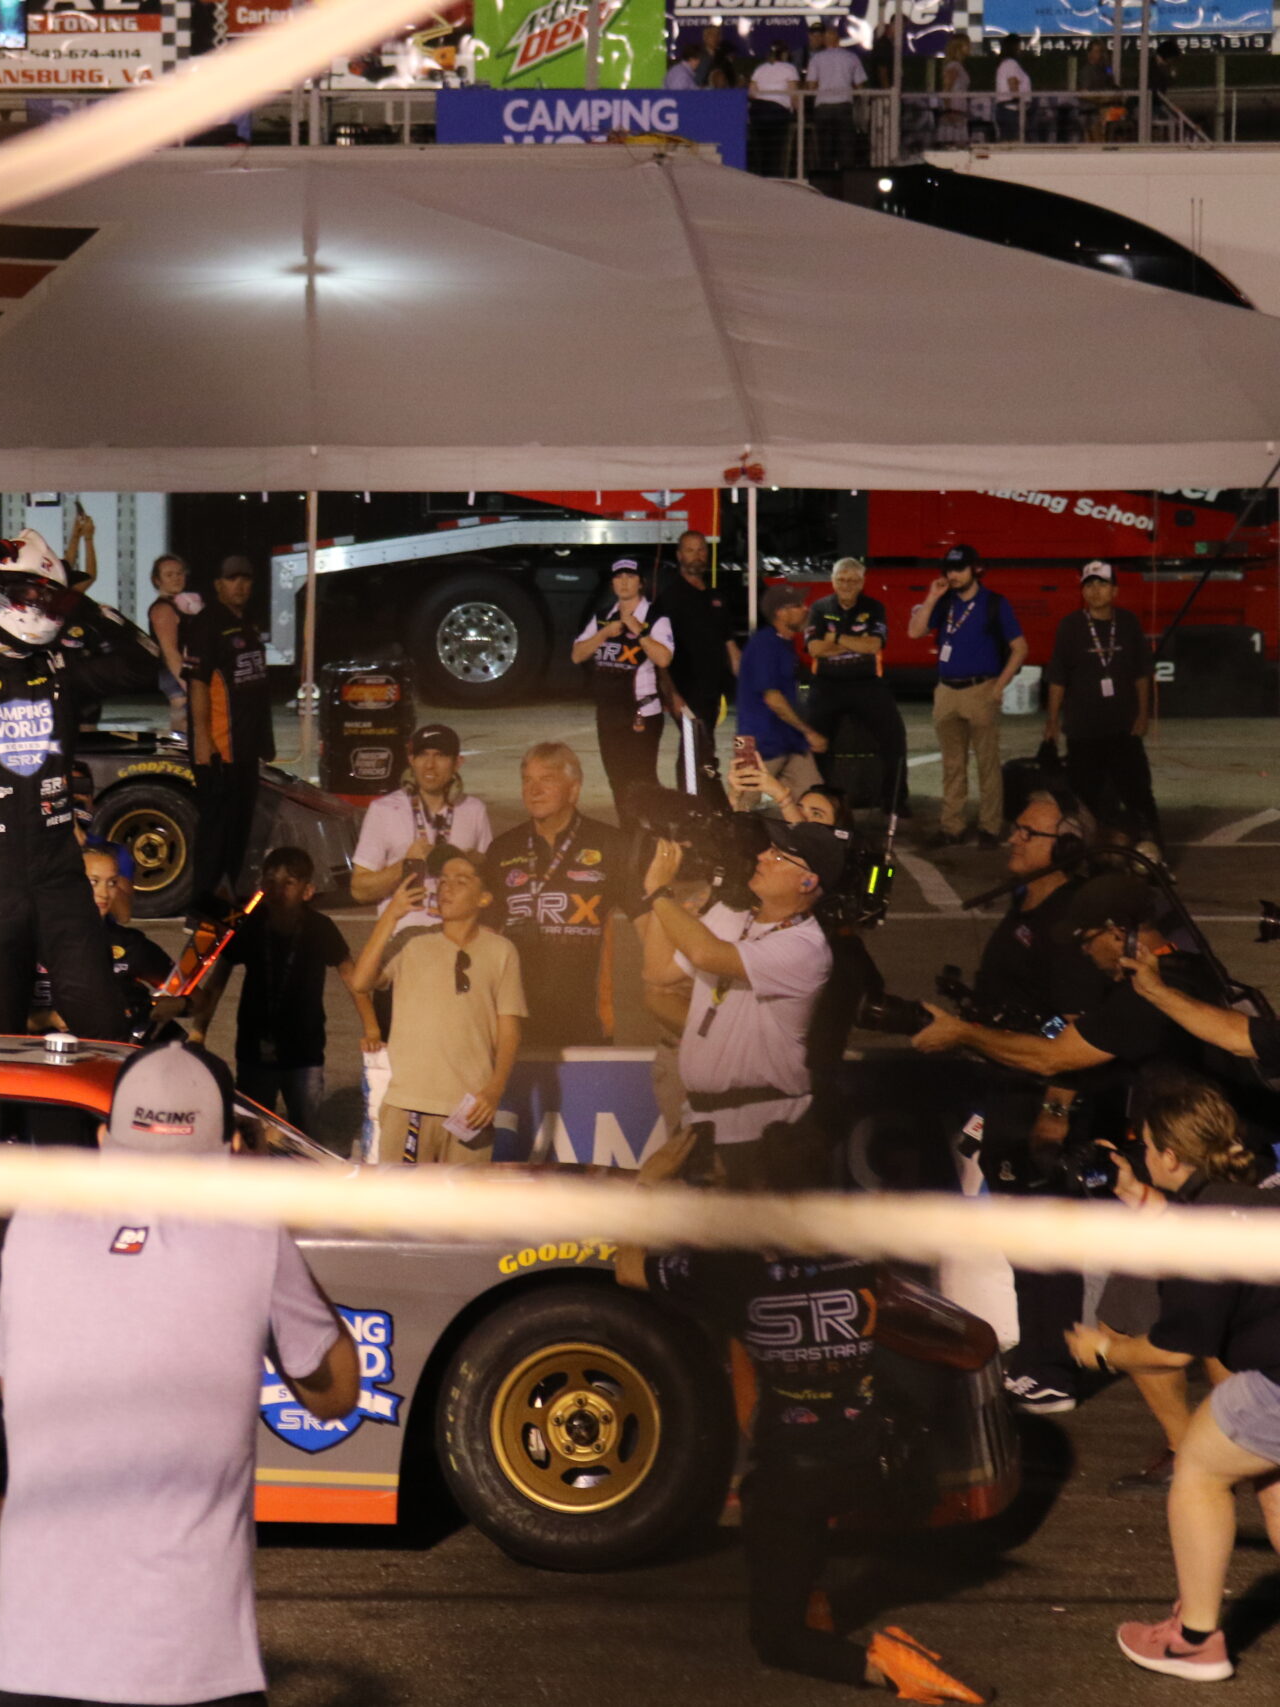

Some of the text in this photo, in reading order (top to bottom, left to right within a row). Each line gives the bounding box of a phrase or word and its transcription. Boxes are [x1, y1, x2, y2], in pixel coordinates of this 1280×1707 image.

[503, 98, 679, 133] CAMPING
[7, 753, 44, 767] SRX
[117, 760, 197, 787] GOODYEA
[506, 892, 603, 926] SRX
[134, 1105, 196, 1125] RACING
[498, 1240, 618, 1274] GOODY
